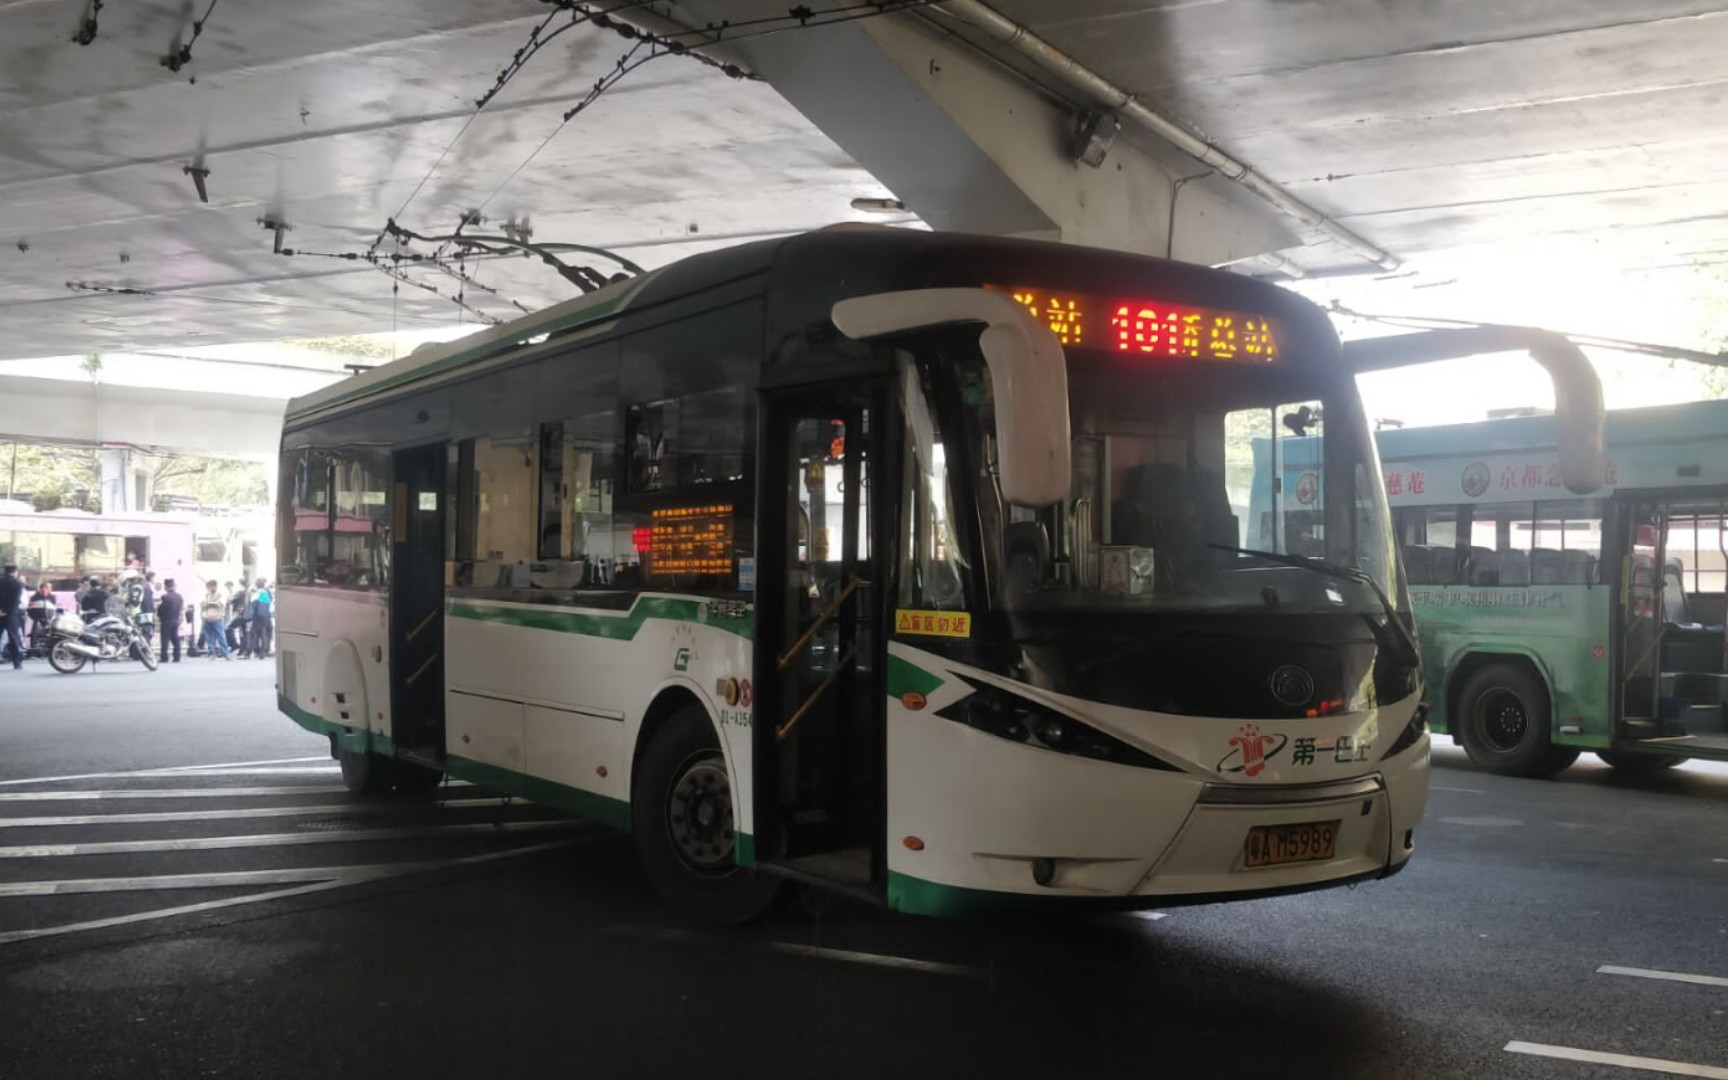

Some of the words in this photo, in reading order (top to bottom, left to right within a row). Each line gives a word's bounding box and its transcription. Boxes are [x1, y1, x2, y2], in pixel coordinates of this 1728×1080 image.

[1112, 306, 1178, 354] 101
[910, 614, 967, 634] 盲区勿近
[1291, 735, 1371, 766] 第一巴士
